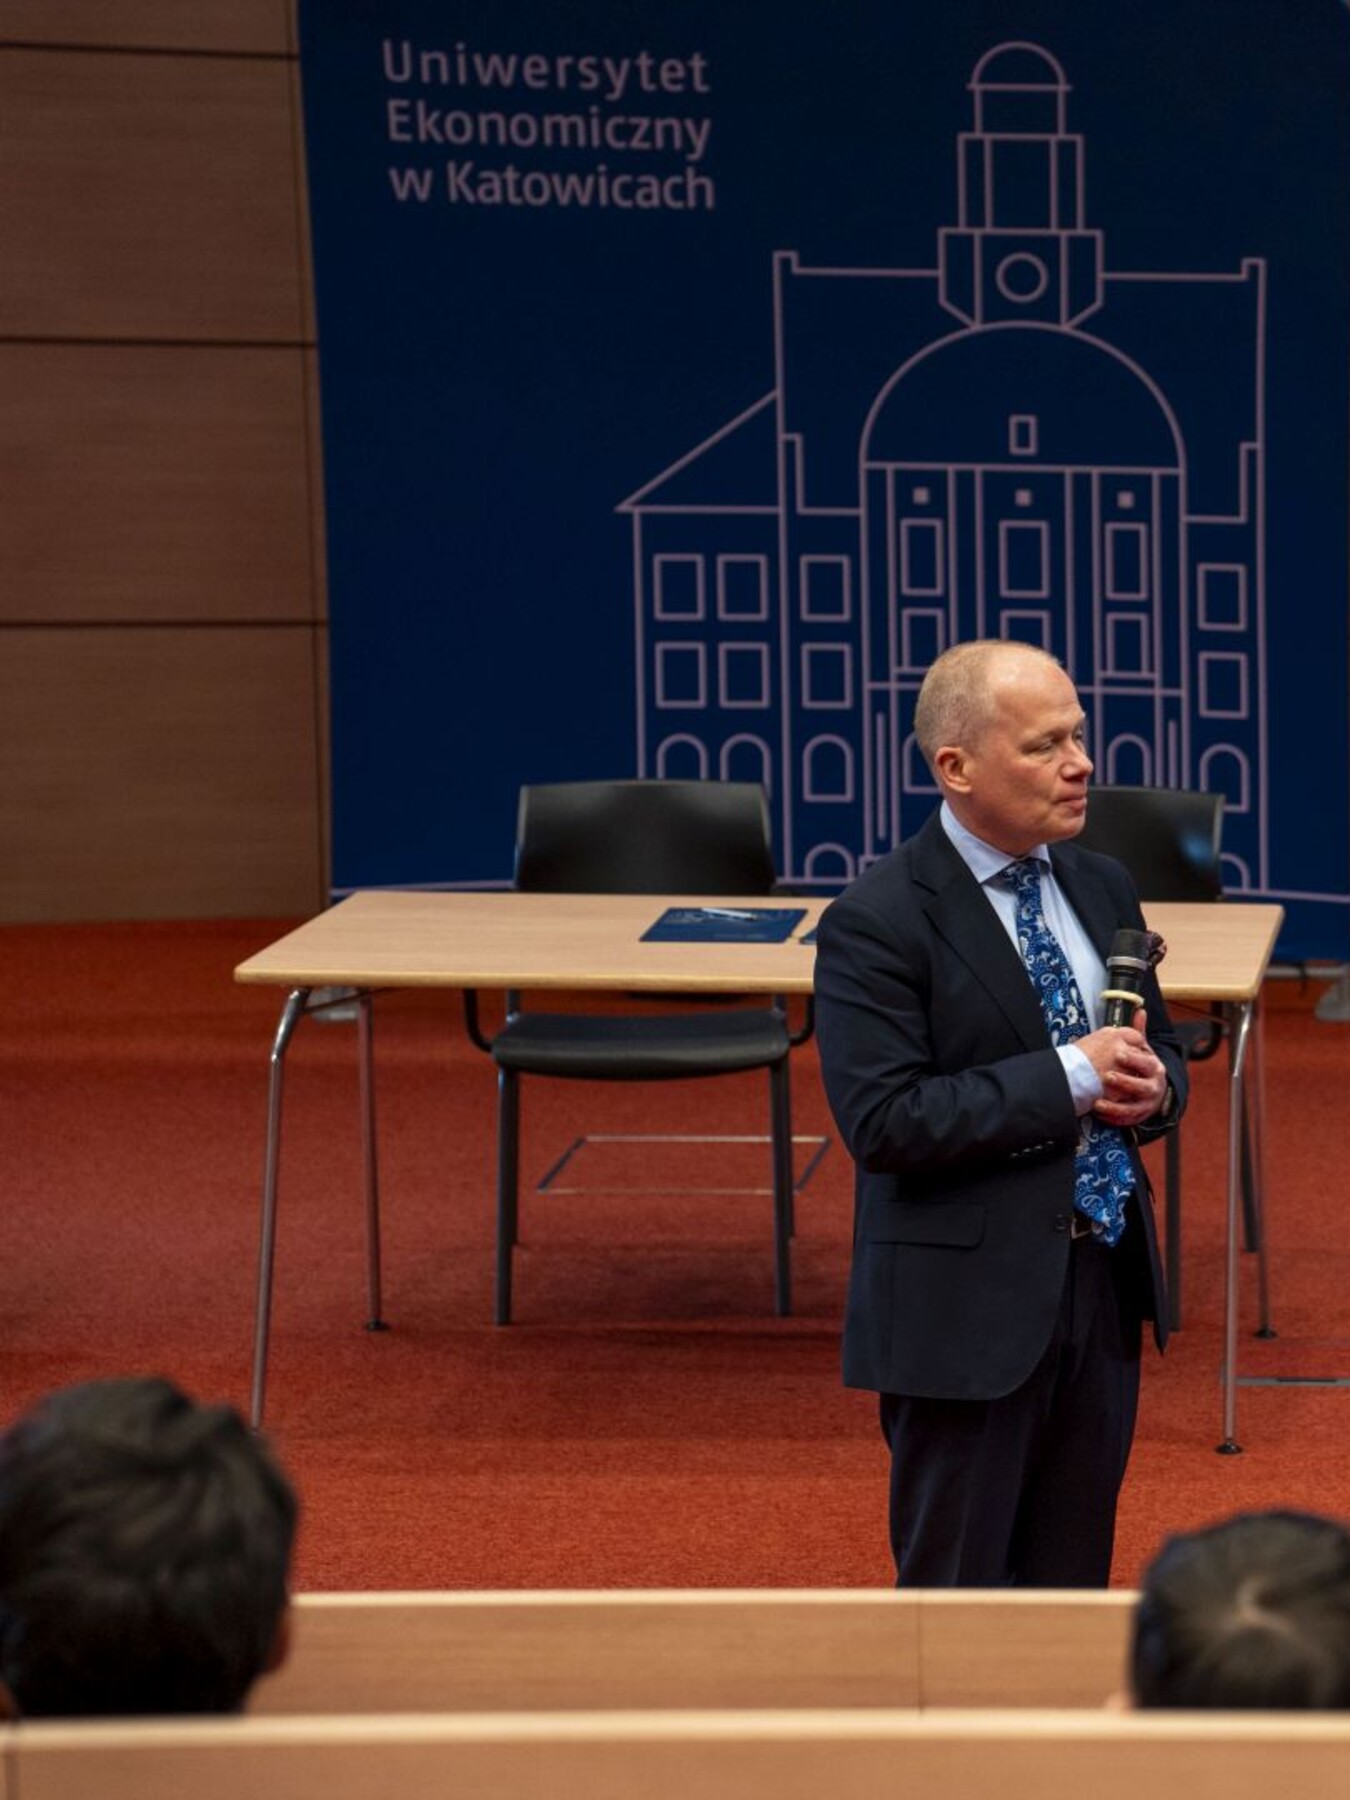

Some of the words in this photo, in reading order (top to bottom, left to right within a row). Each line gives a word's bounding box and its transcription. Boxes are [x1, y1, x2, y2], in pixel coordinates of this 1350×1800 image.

[382, 39, 711, 99] Uniwersytet
[386, 99, 712, 160] Ekonomiczny
[389, 167, 433, 202] w
[447, 160, 715, 209] Katowicach
